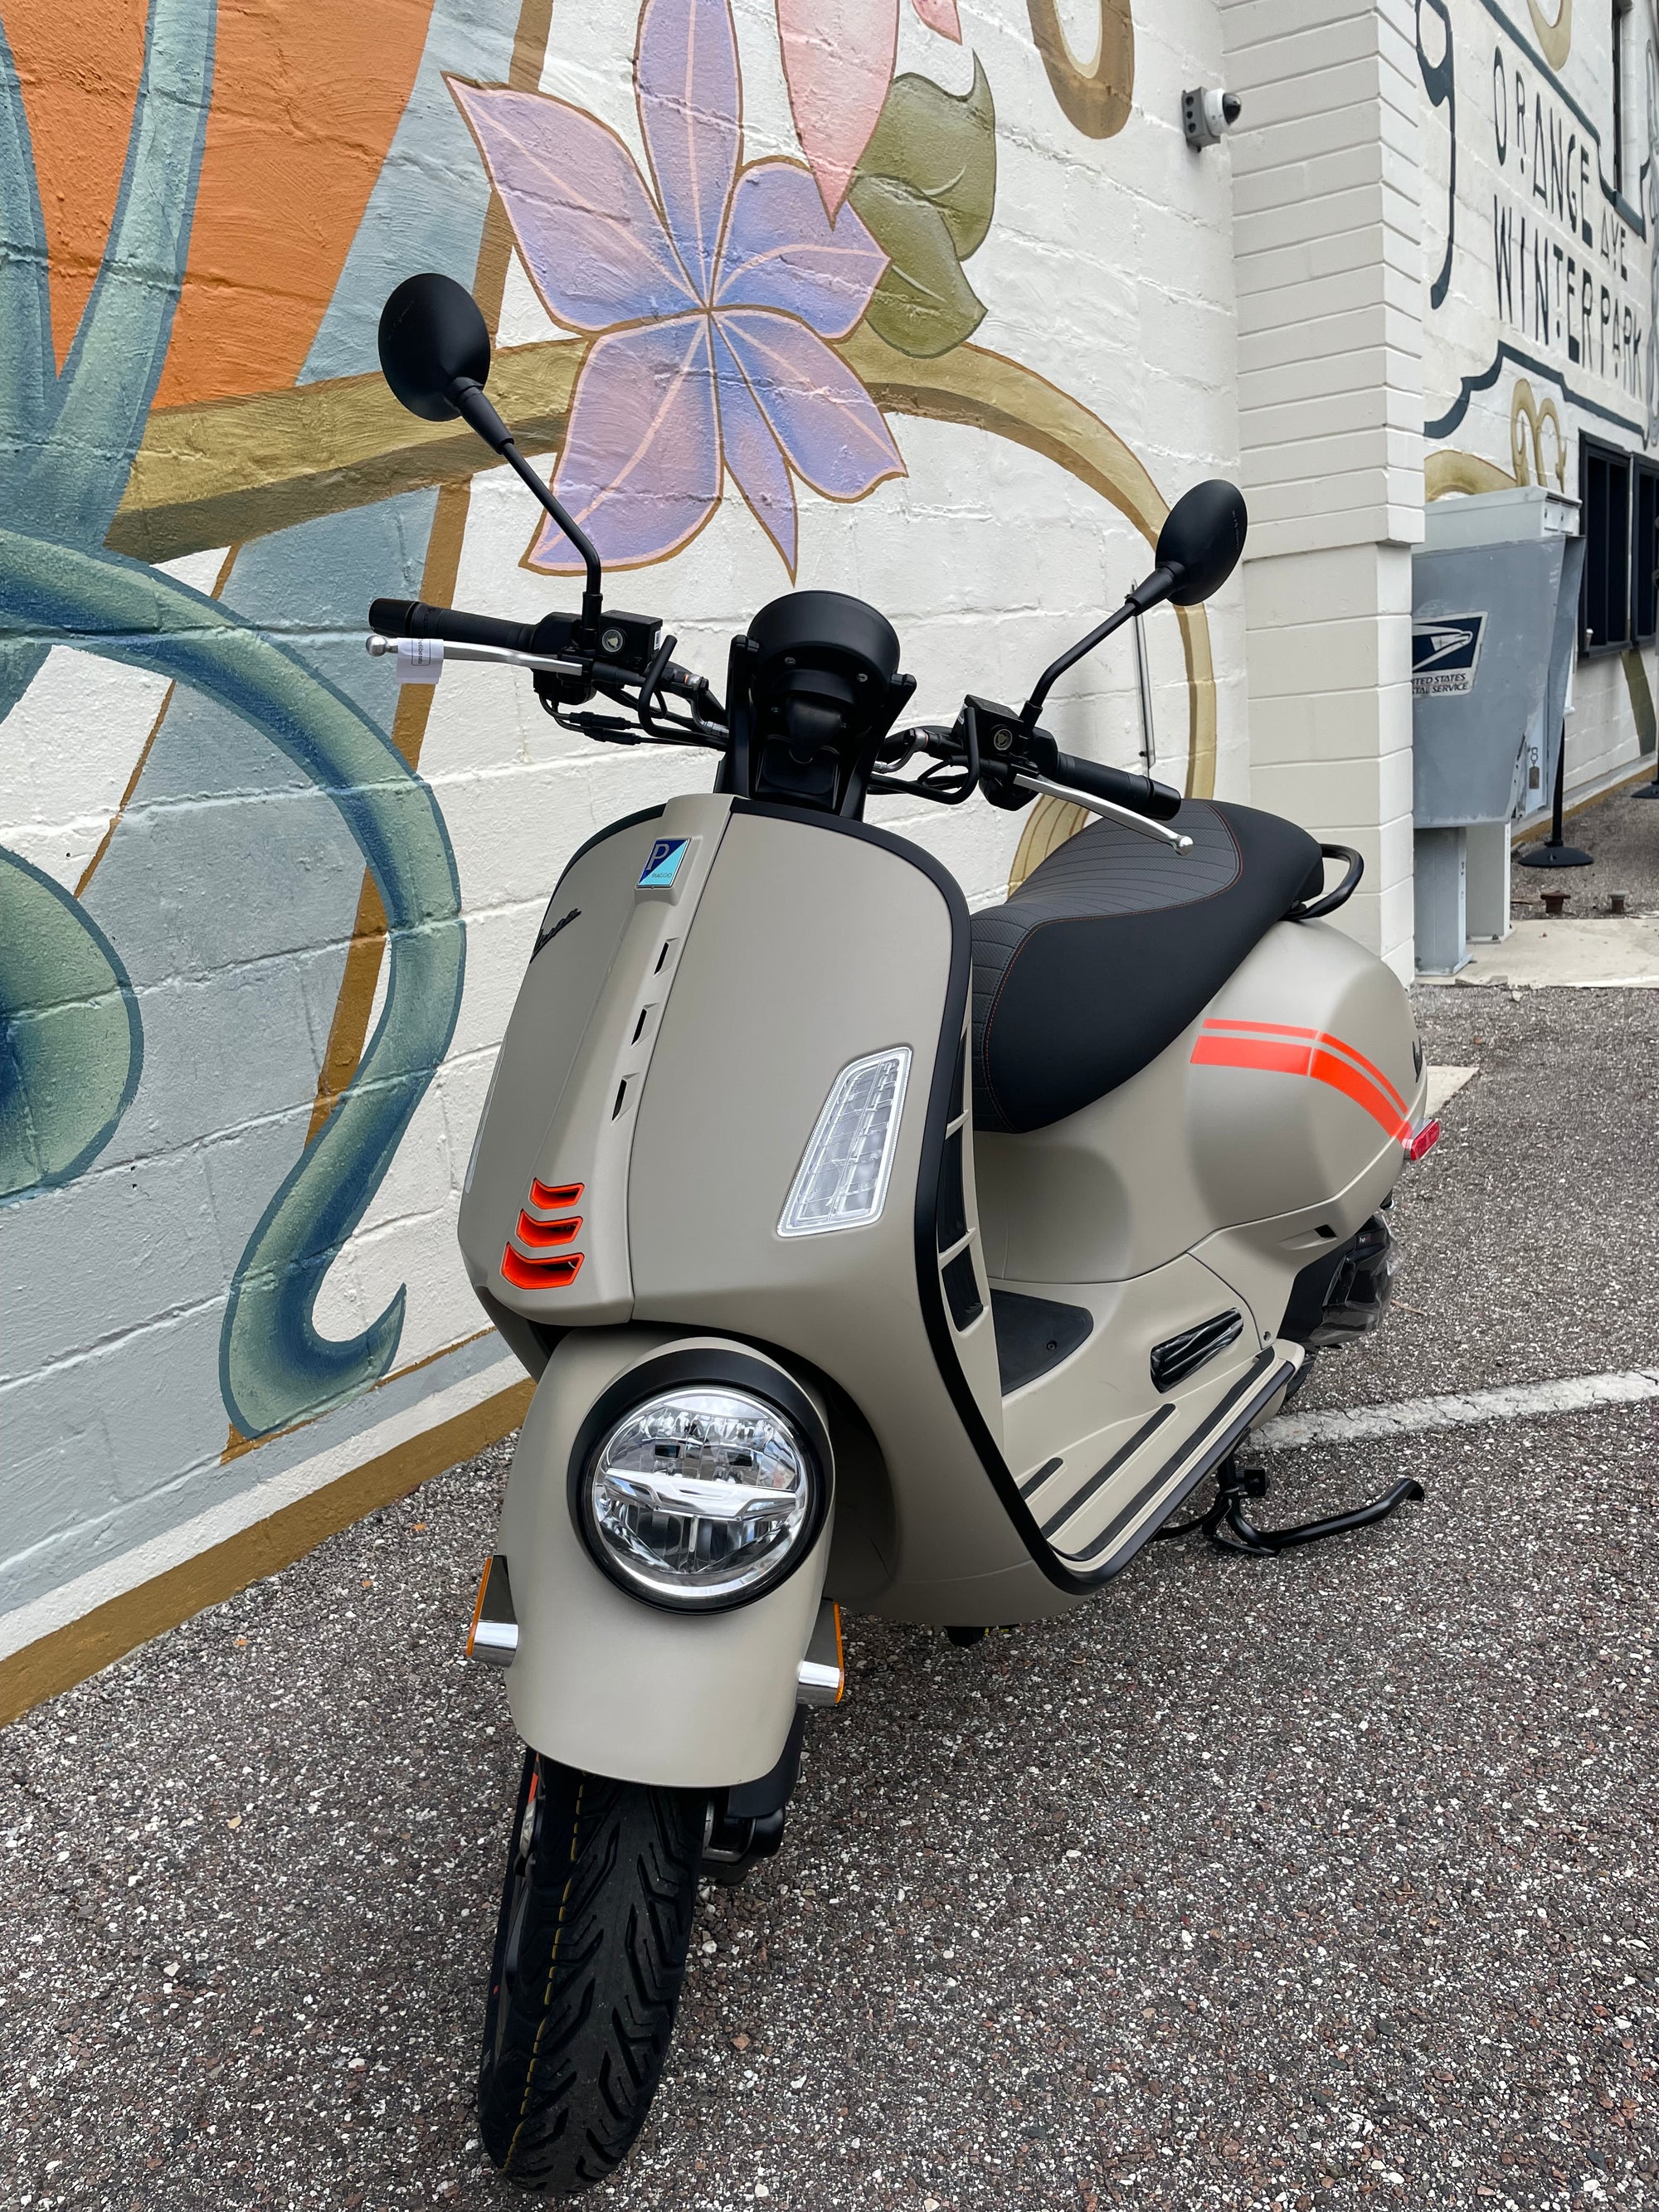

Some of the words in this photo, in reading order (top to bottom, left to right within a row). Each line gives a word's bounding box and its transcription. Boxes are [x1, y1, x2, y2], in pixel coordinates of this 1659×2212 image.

[1494, 46, 1593, 248] ORANGE
[1494, 194, 1592, 372] WINTER
[1601, 284, 1642, 401] PARK
[1412, 676, 1433, 686] ITED
[1434, 673, 1466, 683] STATES
[1432, 682, 1468, 693] SERVICE
[645, 843, 670, 871] P
